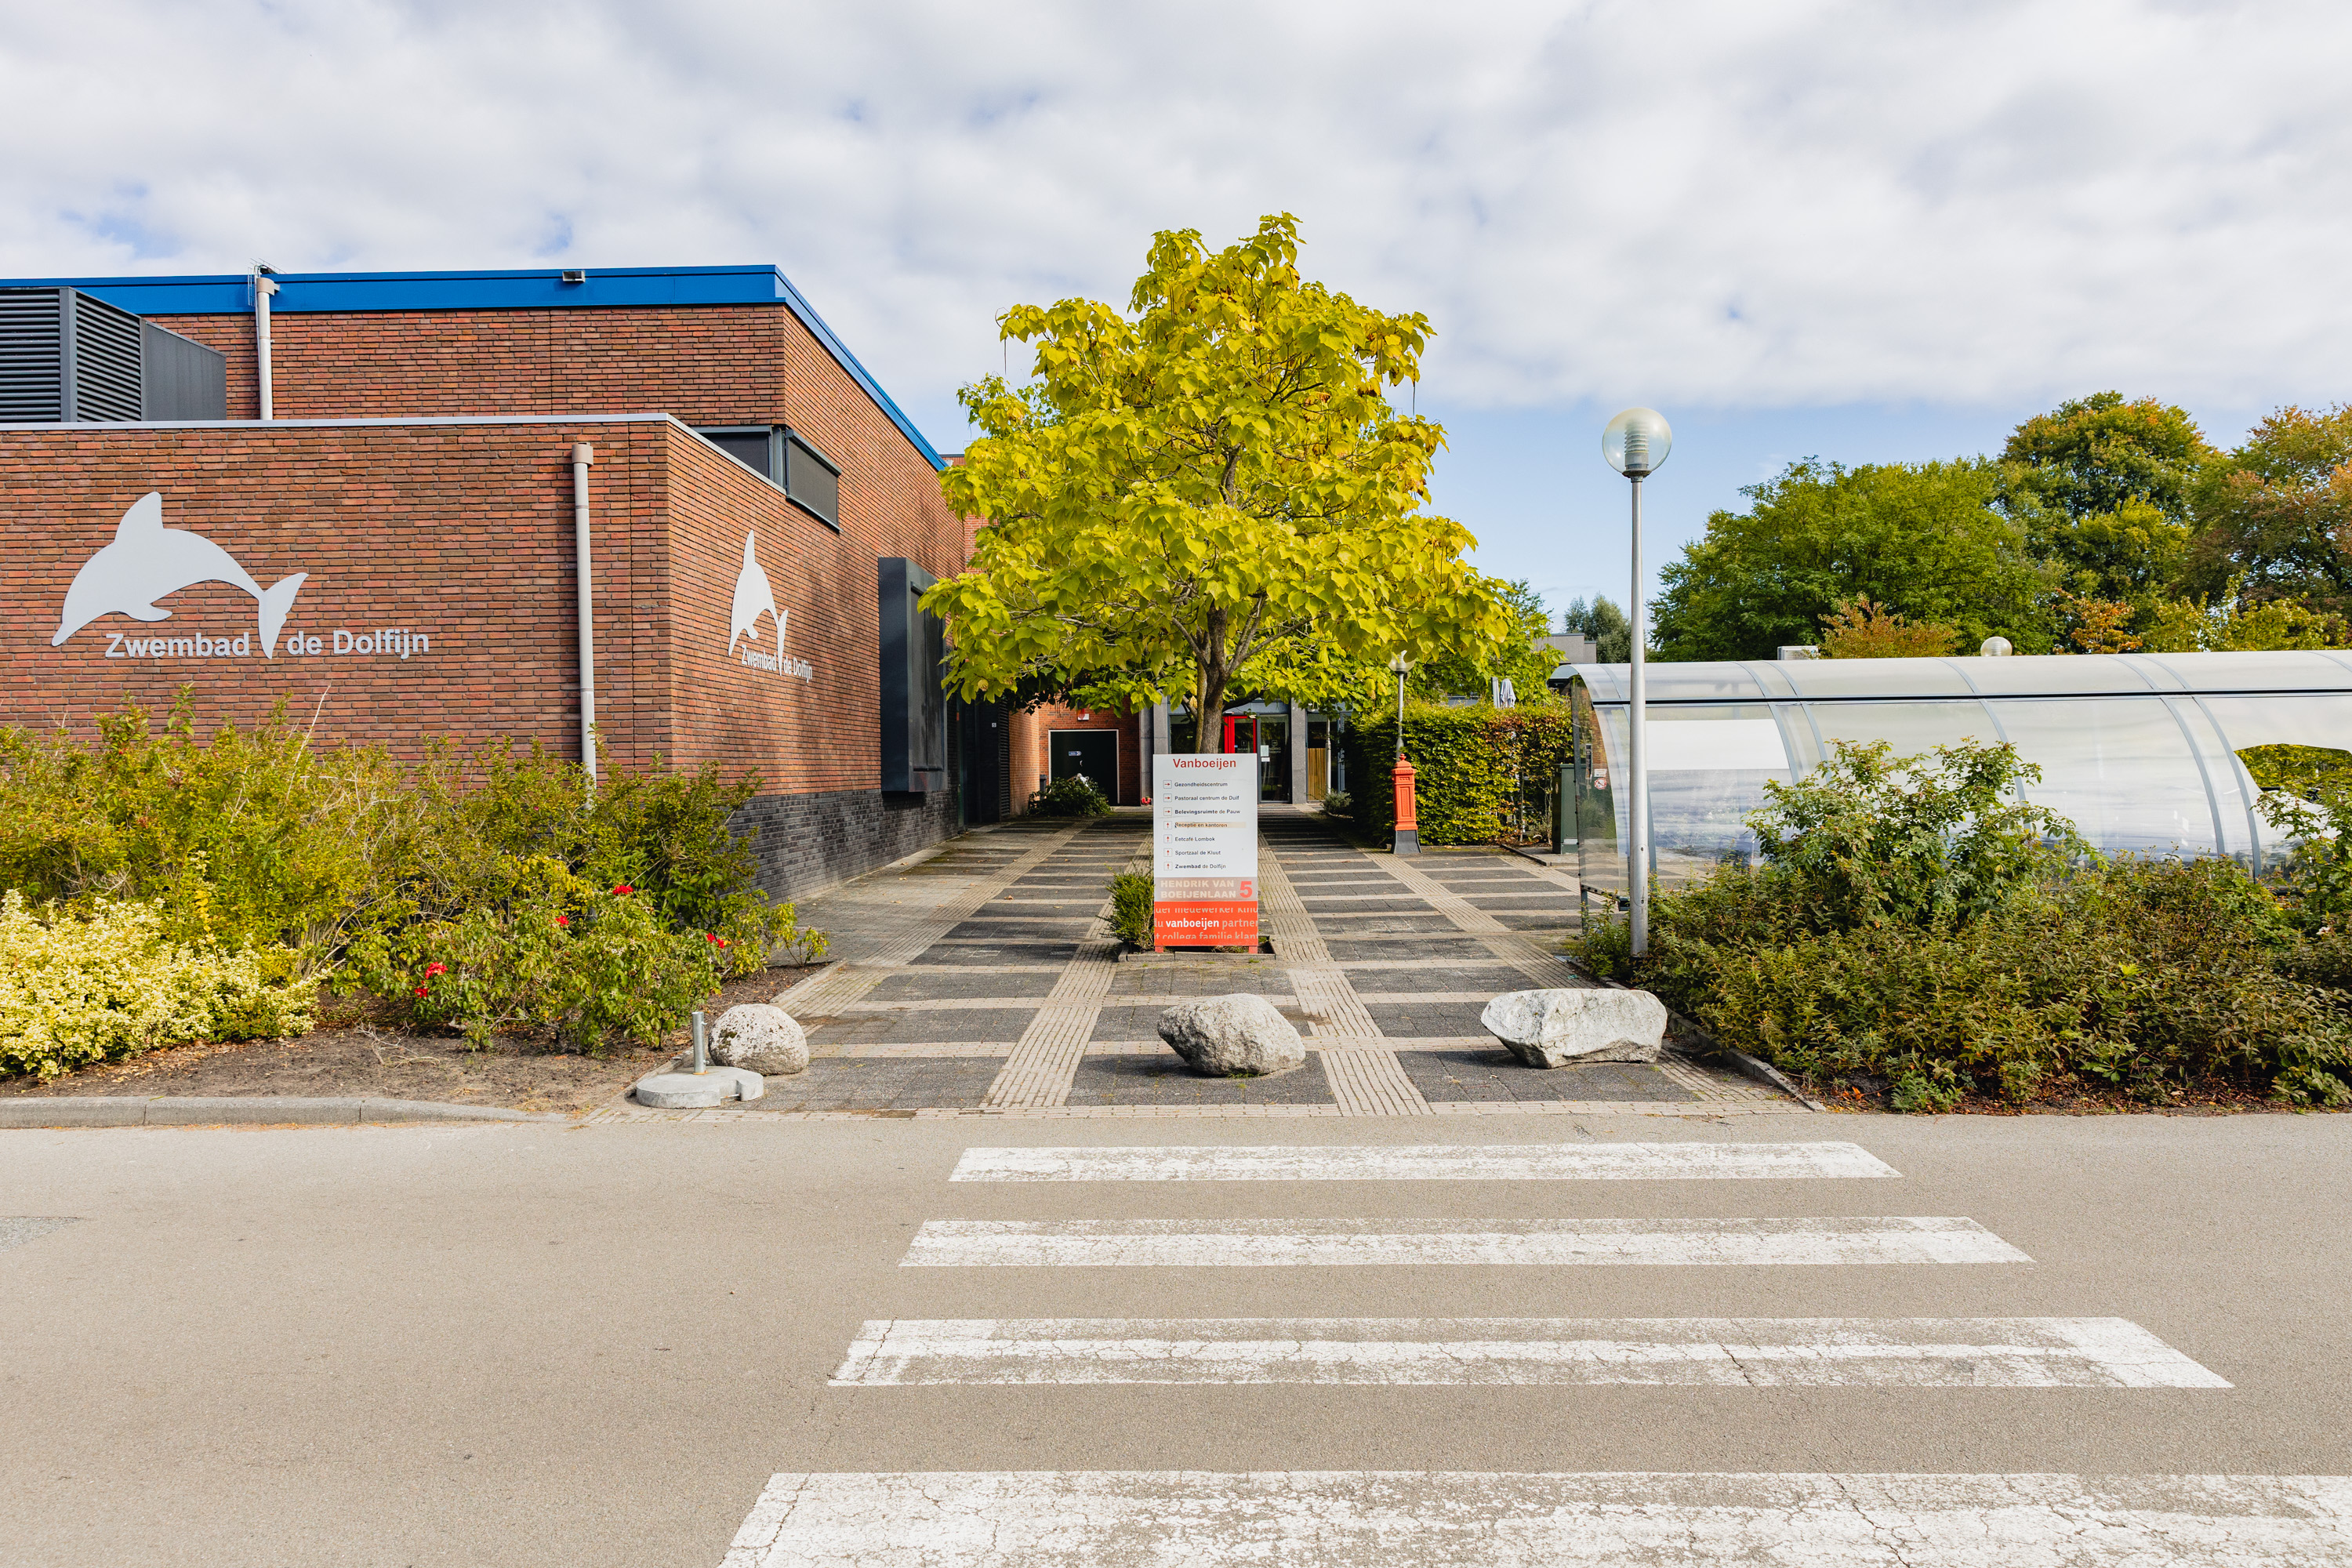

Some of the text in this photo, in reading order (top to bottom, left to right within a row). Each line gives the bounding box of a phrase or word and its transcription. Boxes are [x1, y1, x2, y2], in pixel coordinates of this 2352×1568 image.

[106, 629, 429, 659] Zwembad de Dolfijn
[741, 644, 813, 683] Zwembad de Dolfijn
[1173, 758, 1236, 770] Vanboeijen
[1240, 880, 1253, 898] 5
[1165, 917, 1220, 931] vanboeijen
